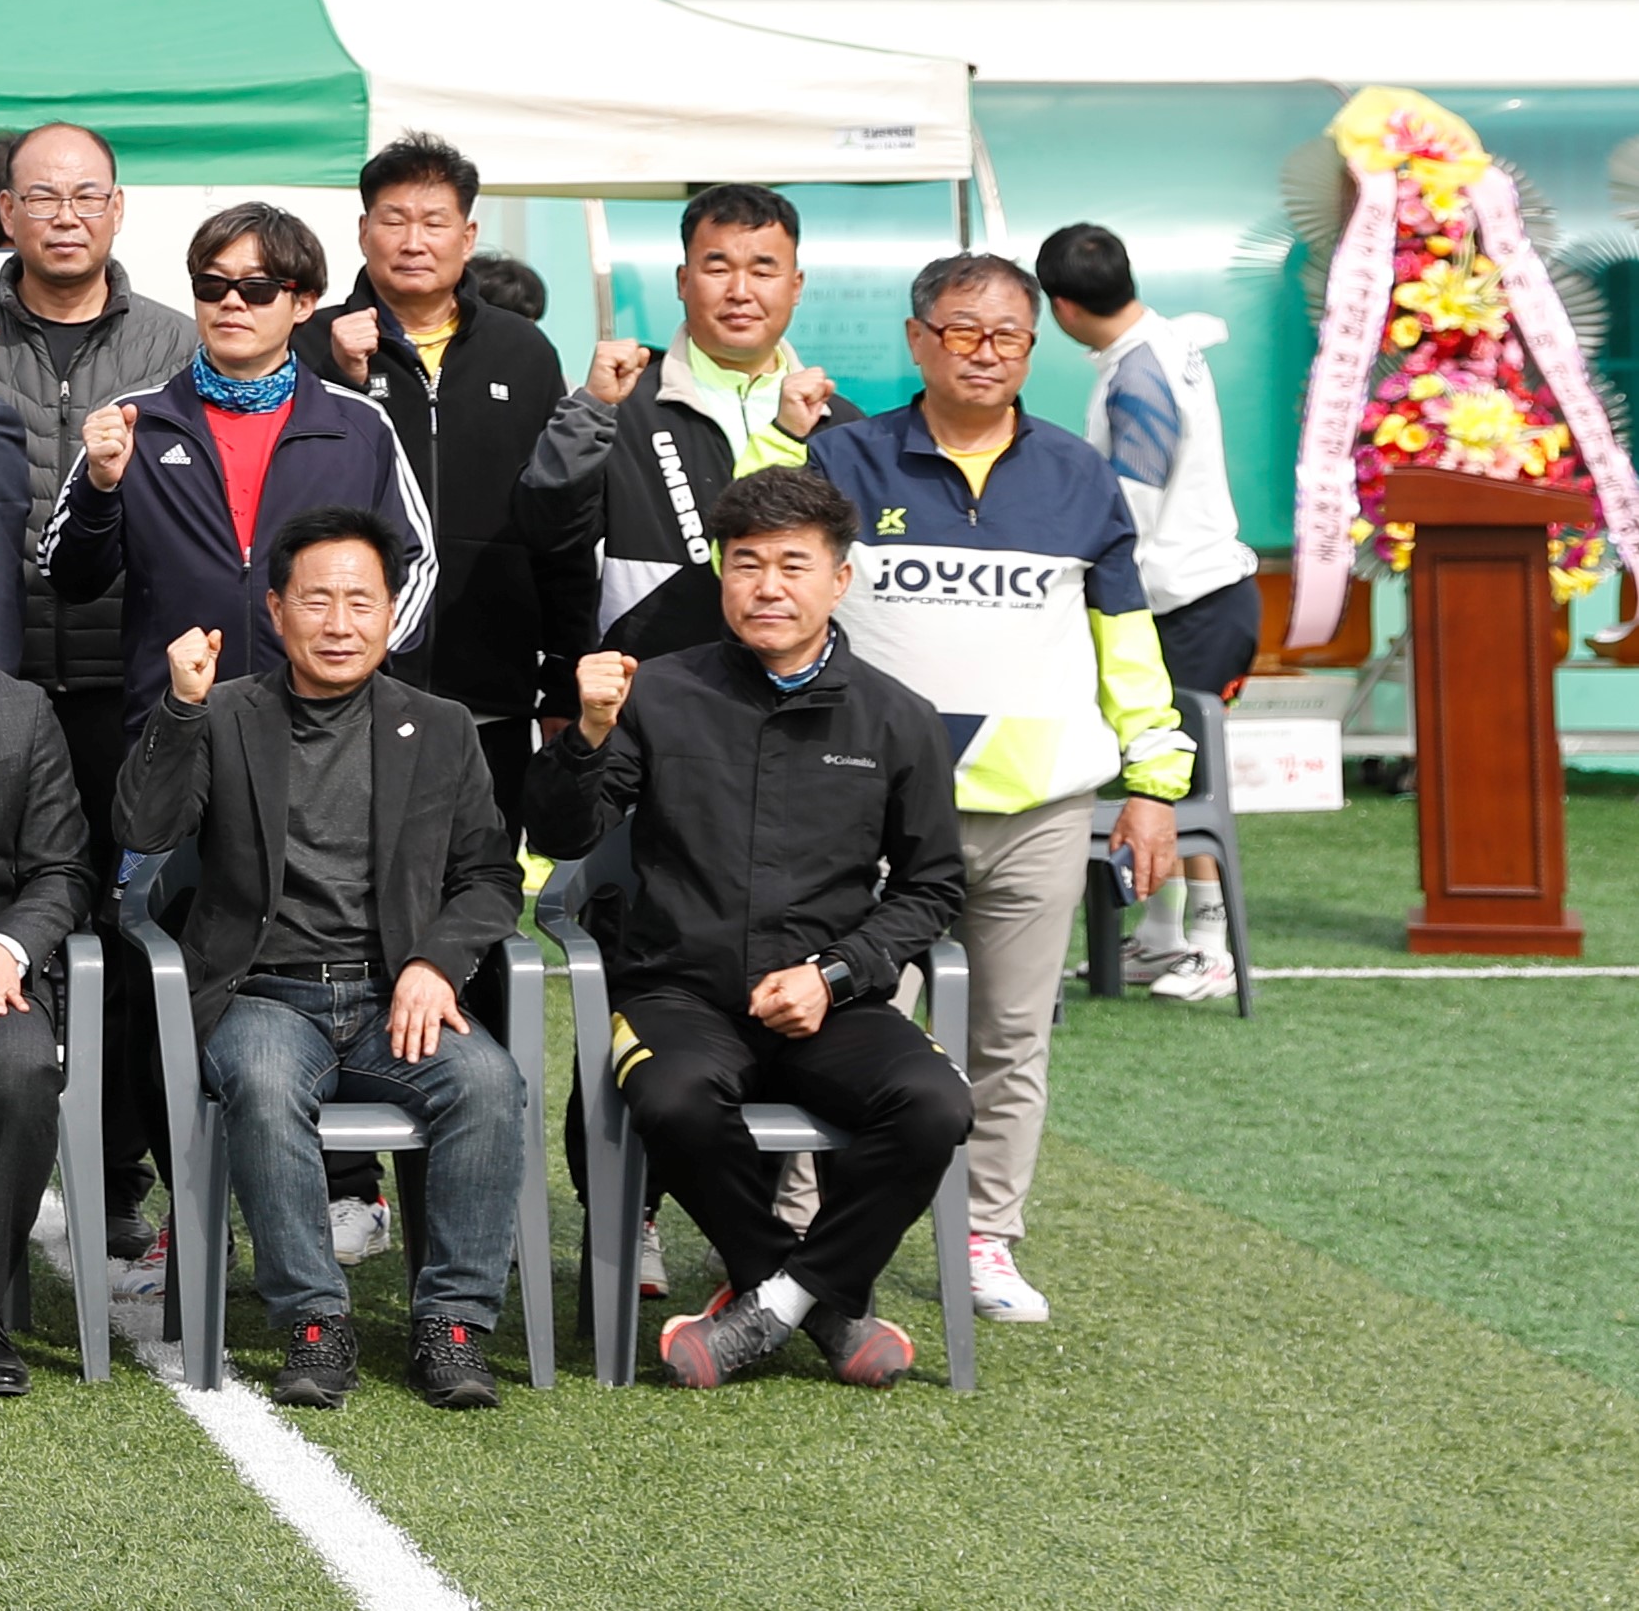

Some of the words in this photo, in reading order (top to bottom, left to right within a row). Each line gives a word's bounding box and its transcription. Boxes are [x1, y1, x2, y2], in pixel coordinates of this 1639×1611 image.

[159, 455, 192, 465] adidas
[651, 430, 712, 565] UMBRO
[873, 594, 1003, 608] PERFORMANCE
[833, 754, 877, 769] Columbia
